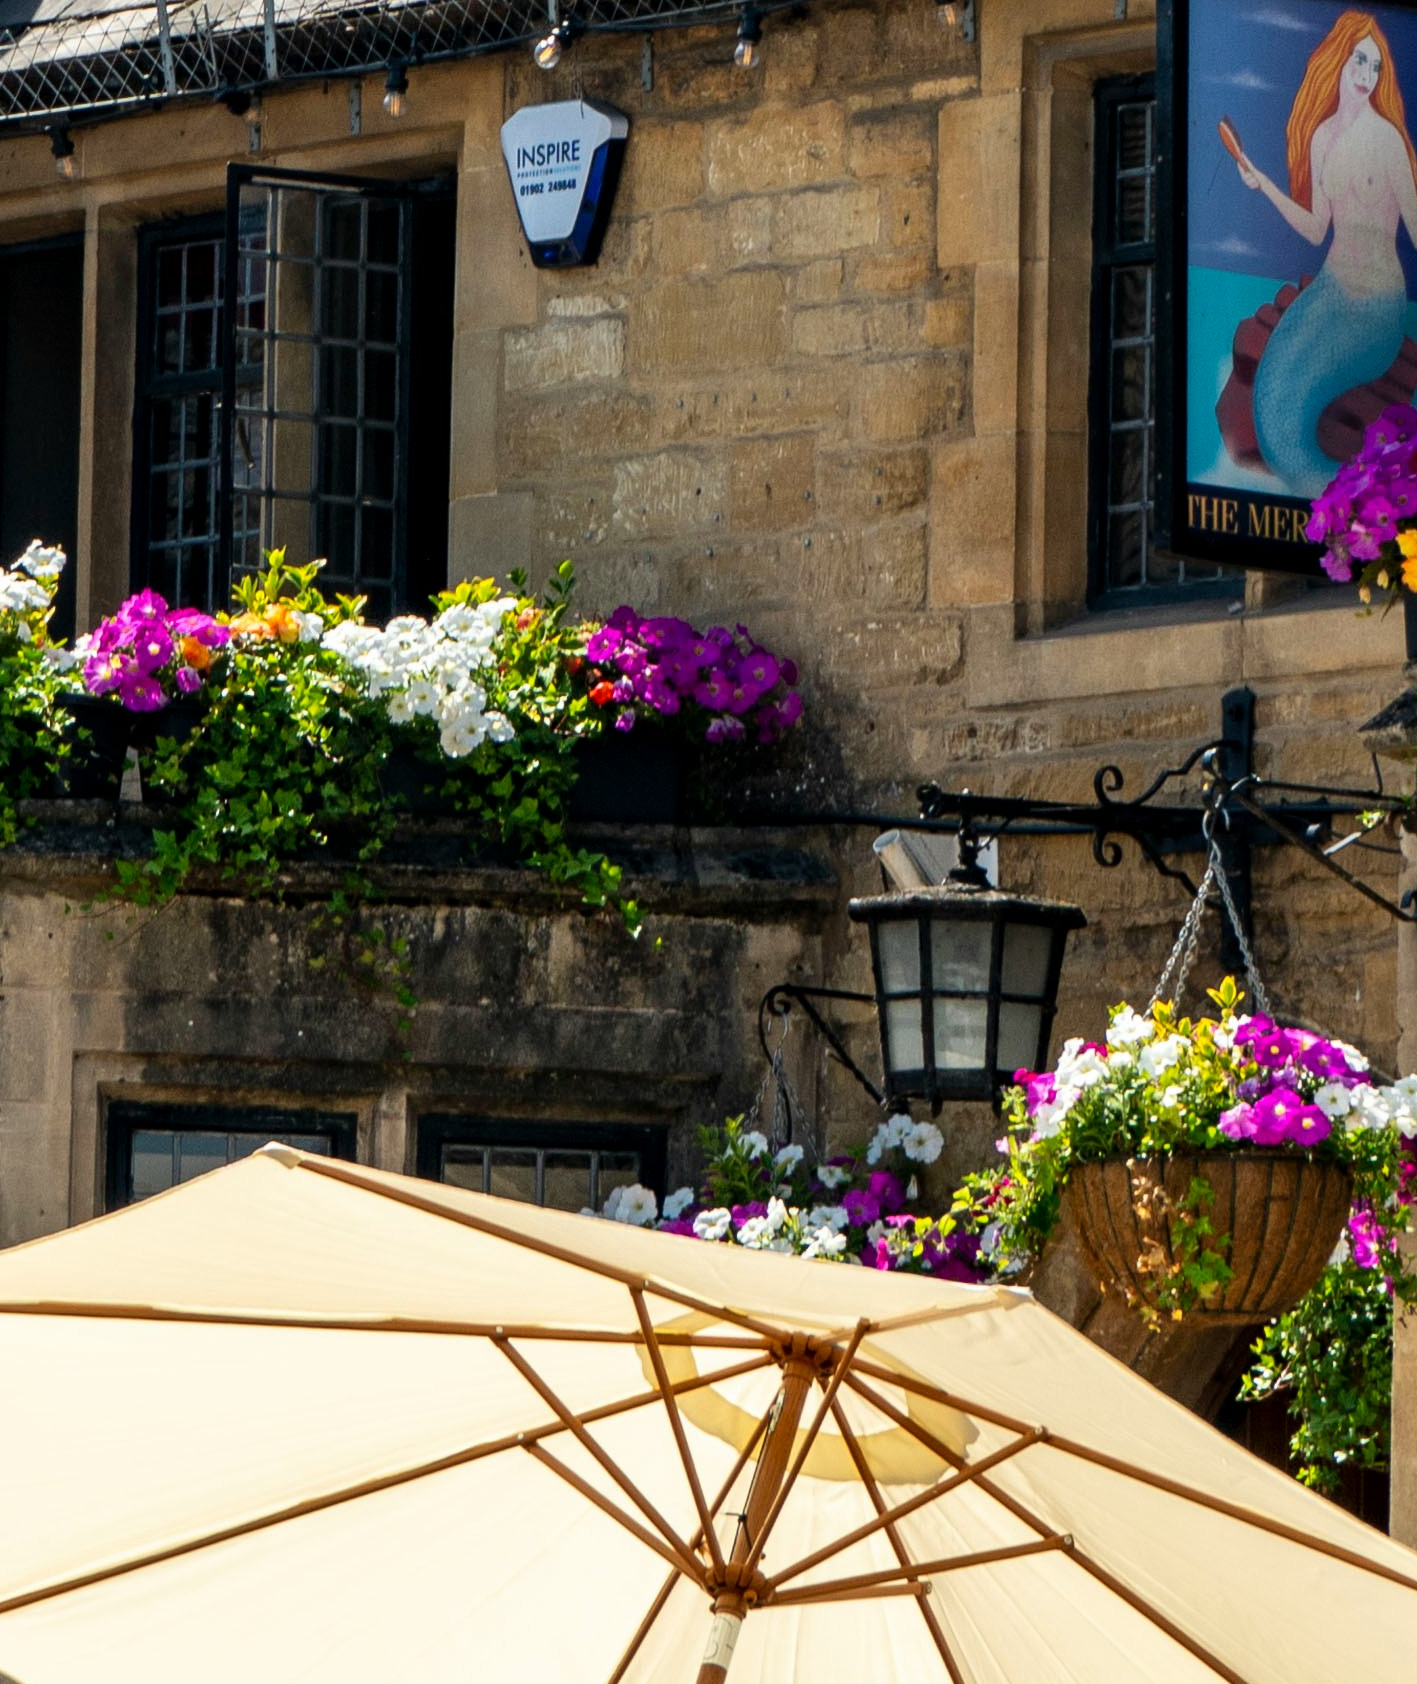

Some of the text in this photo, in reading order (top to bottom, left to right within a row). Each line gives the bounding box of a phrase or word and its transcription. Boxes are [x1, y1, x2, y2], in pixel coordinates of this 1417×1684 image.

[517, 140, 580, 169] INSPIRE
[520, 182, 544, 196] 01902
[1187, 494, 1310, 544] THE MER
